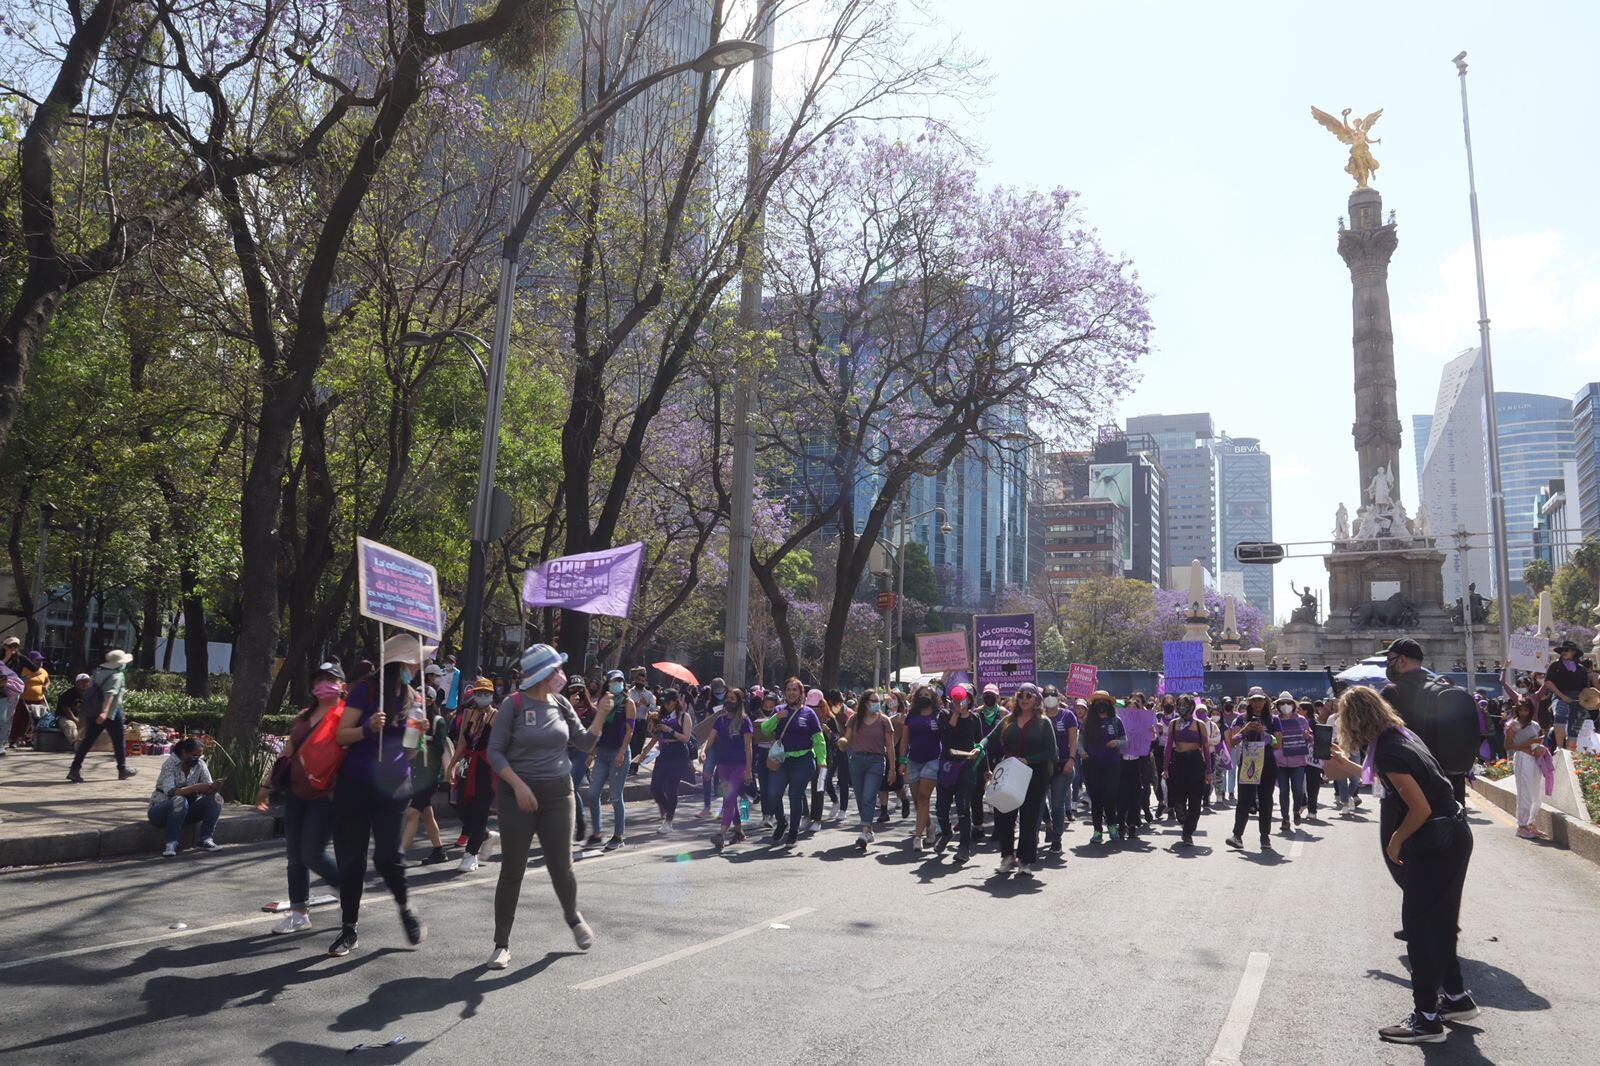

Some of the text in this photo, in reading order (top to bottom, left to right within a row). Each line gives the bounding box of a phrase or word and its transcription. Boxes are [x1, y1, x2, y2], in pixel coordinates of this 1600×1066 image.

[1234, 443, 1259, 453] BBVA
[978, 627, 1032, 639] LAS CONEXIONES
[980, 637, 1032, 649] mujeres
